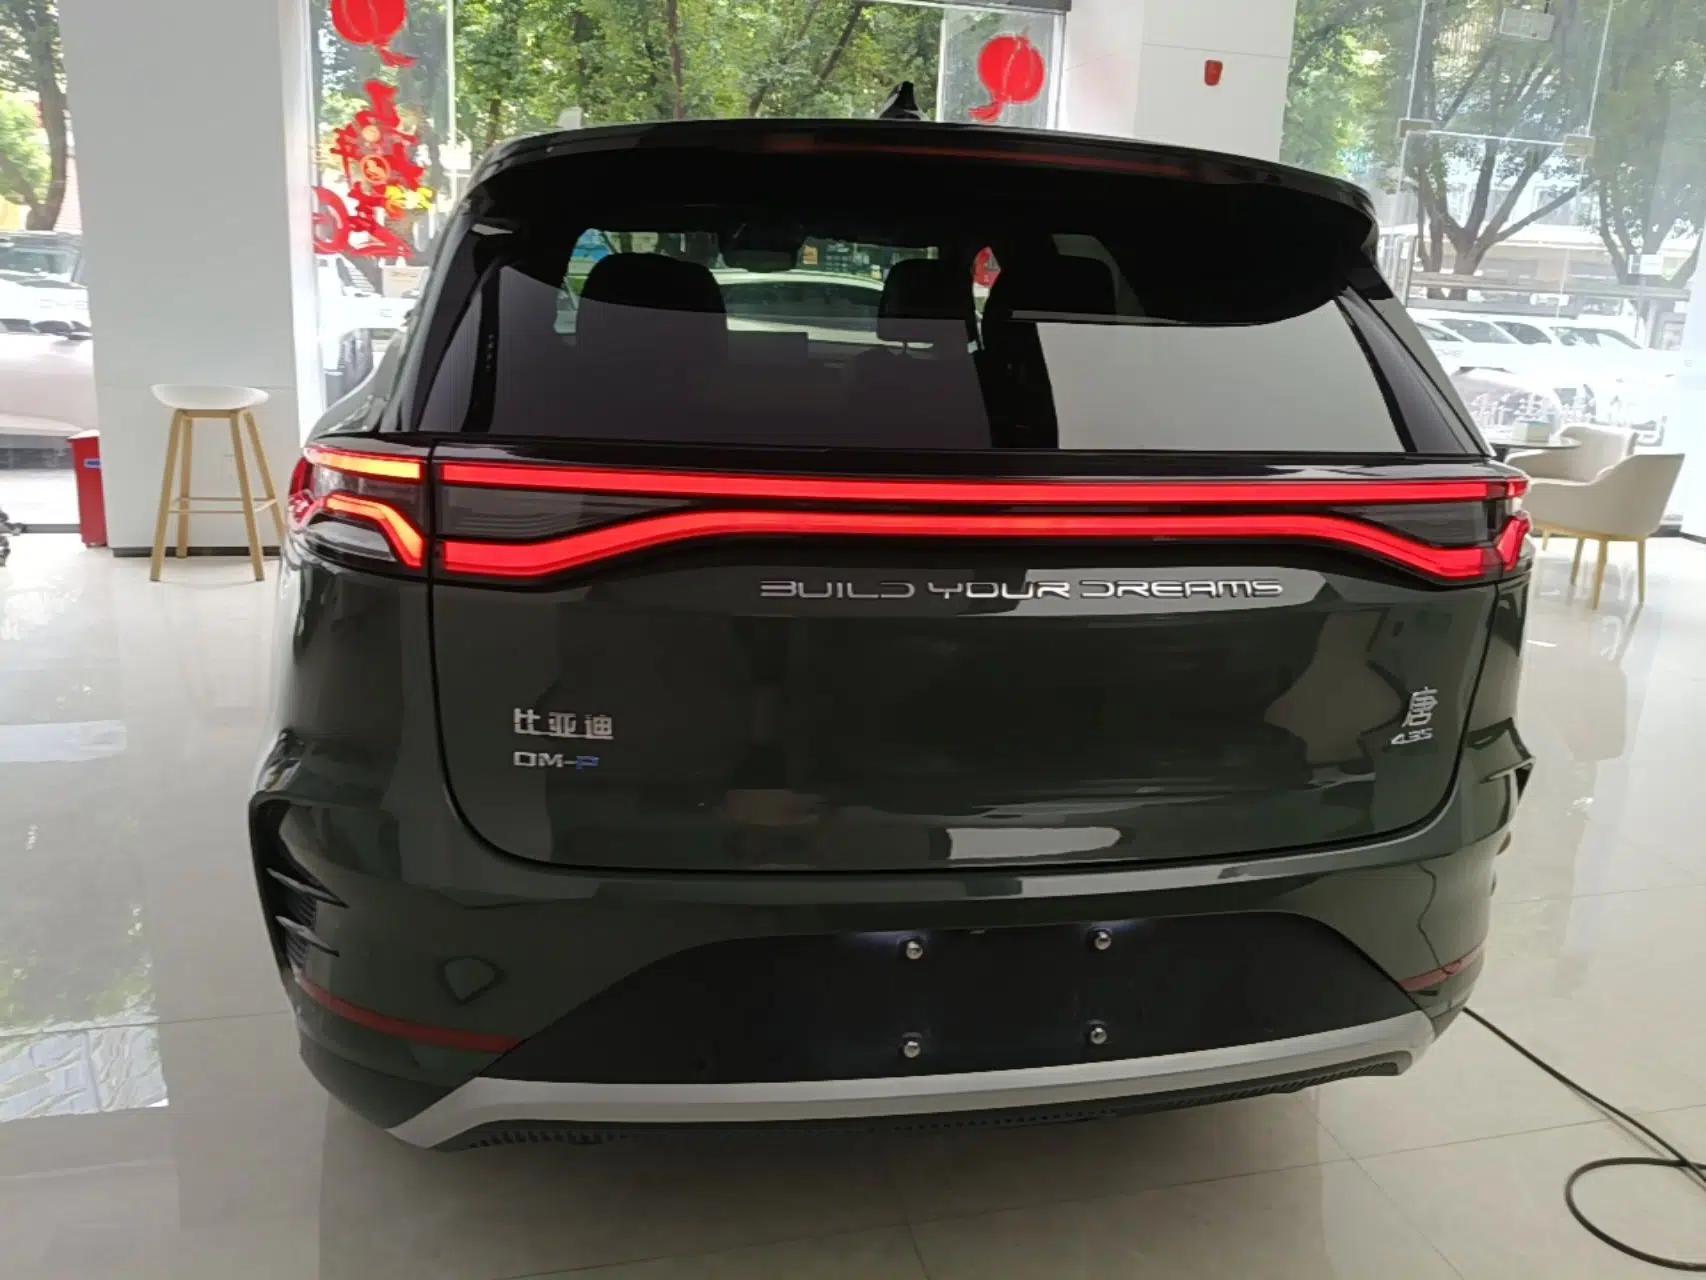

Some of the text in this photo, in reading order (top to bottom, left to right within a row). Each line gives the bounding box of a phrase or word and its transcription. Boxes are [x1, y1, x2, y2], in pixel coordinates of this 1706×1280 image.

[760, 579, 1284, 600] BUILD YOUR DREAMS
[513, 707, 614, 740] 比亚迪
[1401, 686, 1438, 728] 唐
